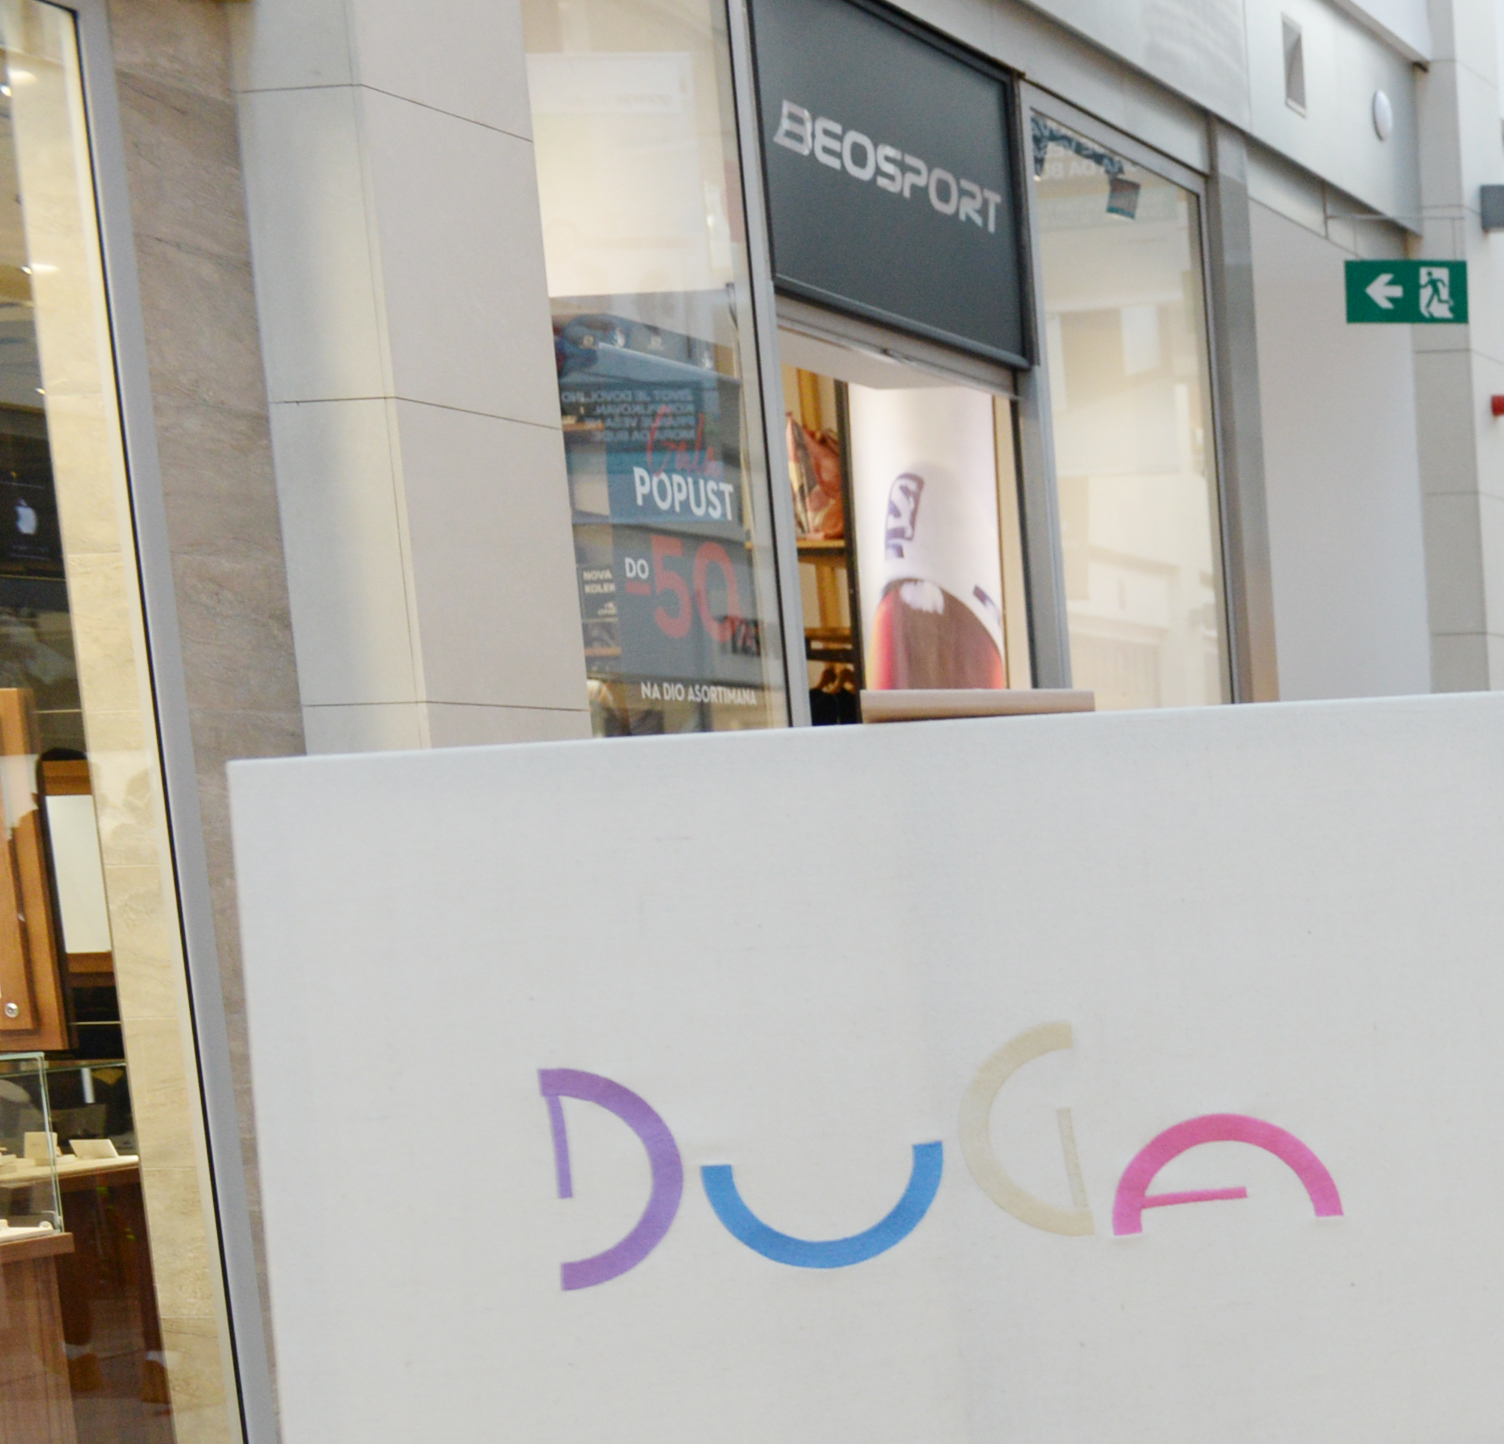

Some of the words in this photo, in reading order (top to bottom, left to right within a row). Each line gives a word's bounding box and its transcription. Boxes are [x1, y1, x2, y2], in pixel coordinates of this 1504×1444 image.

[773, 99, 1002, 234] BEOSPORT
[633, 467, 735, 521] POPUST
[624, 557, 650, 580] DO
[641, 681, 662, 701] NA
[663, 682, 685, 702] DIO
[687, 684, 758, 706] ASORTIMANA
[537, 1021, 1344, 1291] DUGA
